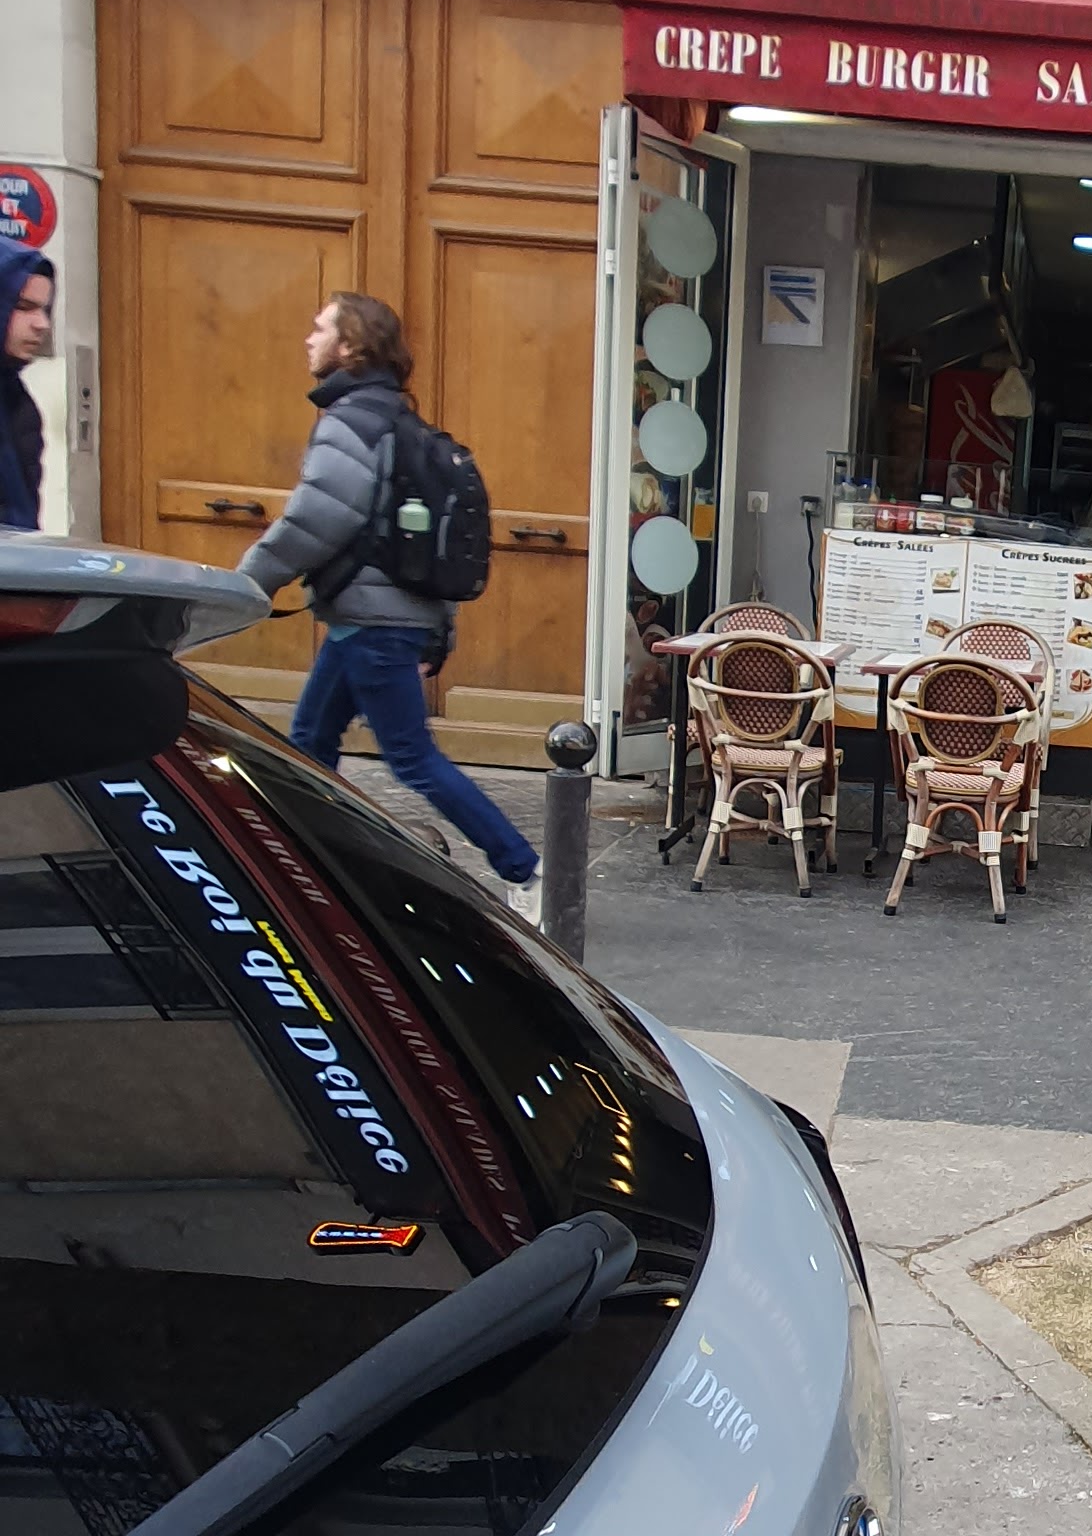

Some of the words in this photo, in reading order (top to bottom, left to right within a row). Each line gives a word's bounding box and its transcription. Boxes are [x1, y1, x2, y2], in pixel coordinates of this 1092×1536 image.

[655, 25, 782, 79] CREPE
[826, 40, 989, 97] BURGER
[0, 177, 28, 196] OUR
